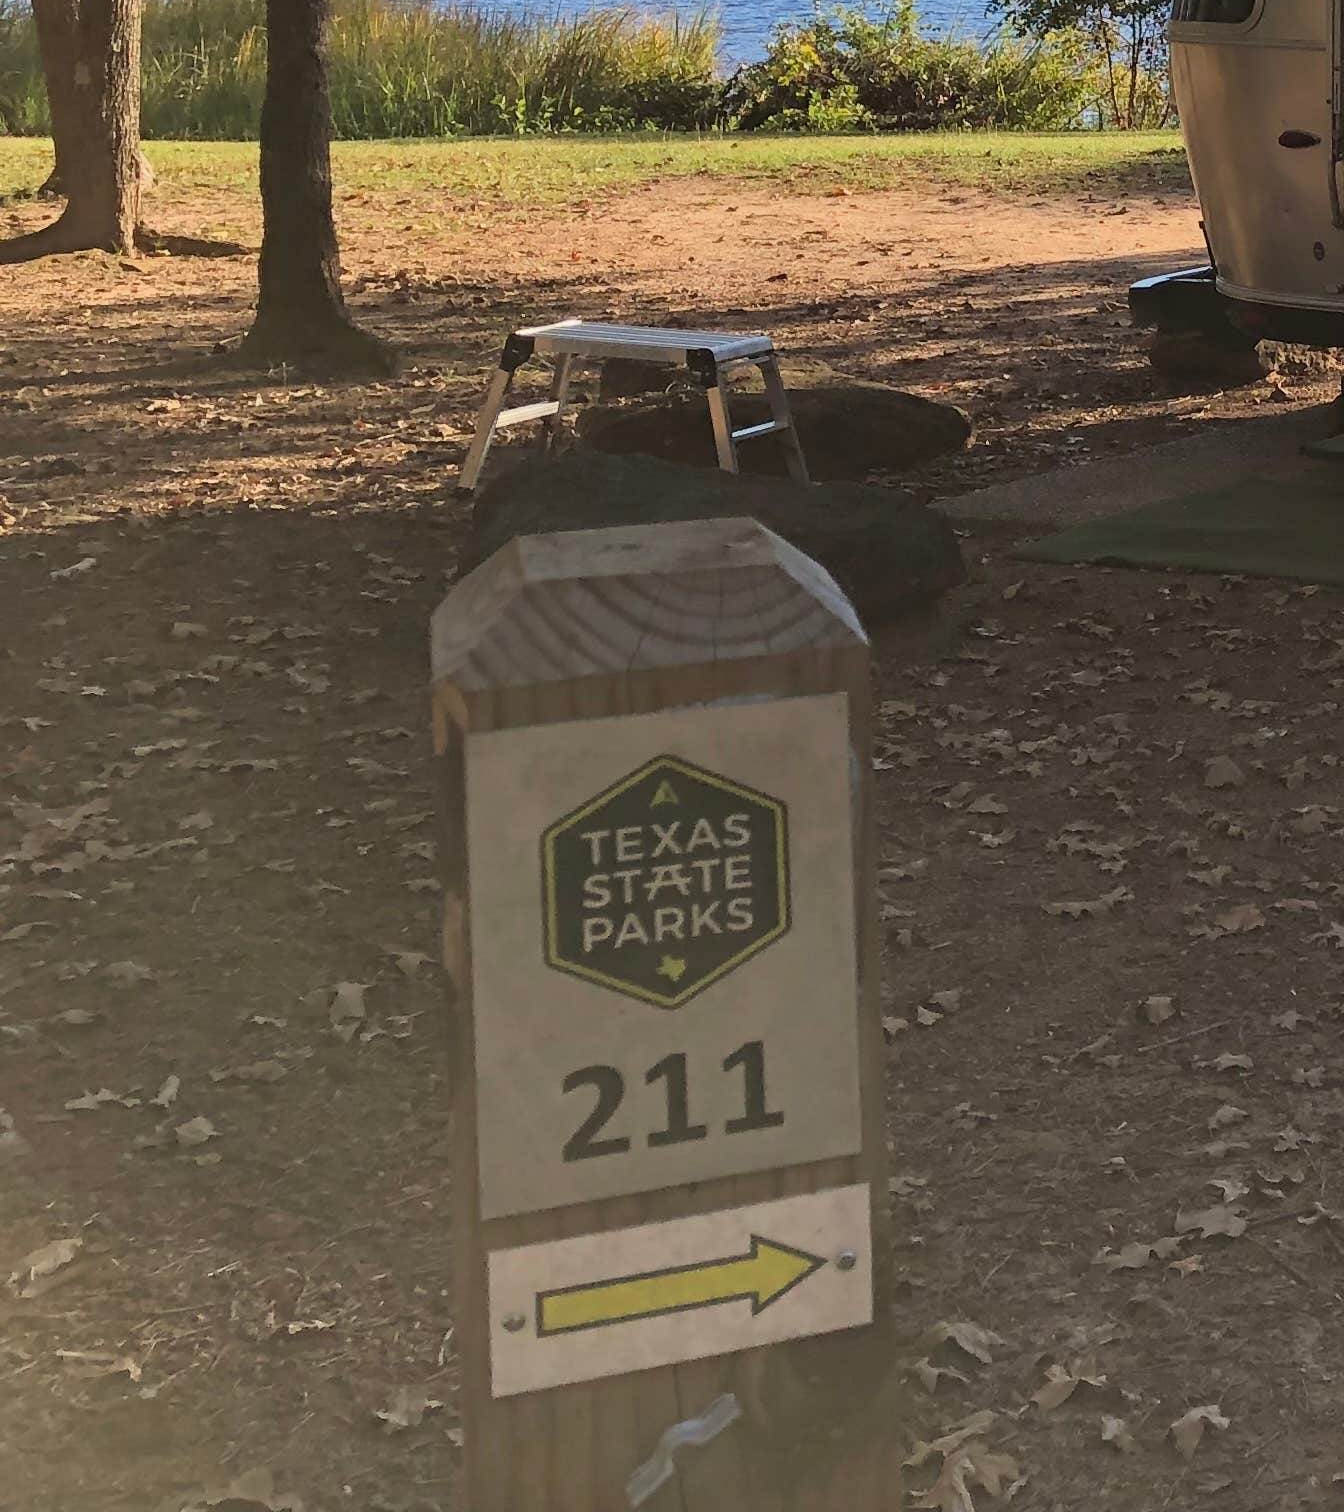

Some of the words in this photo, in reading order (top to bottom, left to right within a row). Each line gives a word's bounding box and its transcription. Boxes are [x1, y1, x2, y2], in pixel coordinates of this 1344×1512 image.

[579, 813, 752, 865] TEXAS
[581, 855, 753, 909] STATE
[582, 897, 754, 953] PARKS
[561, 1039, 785, 1163] 211
